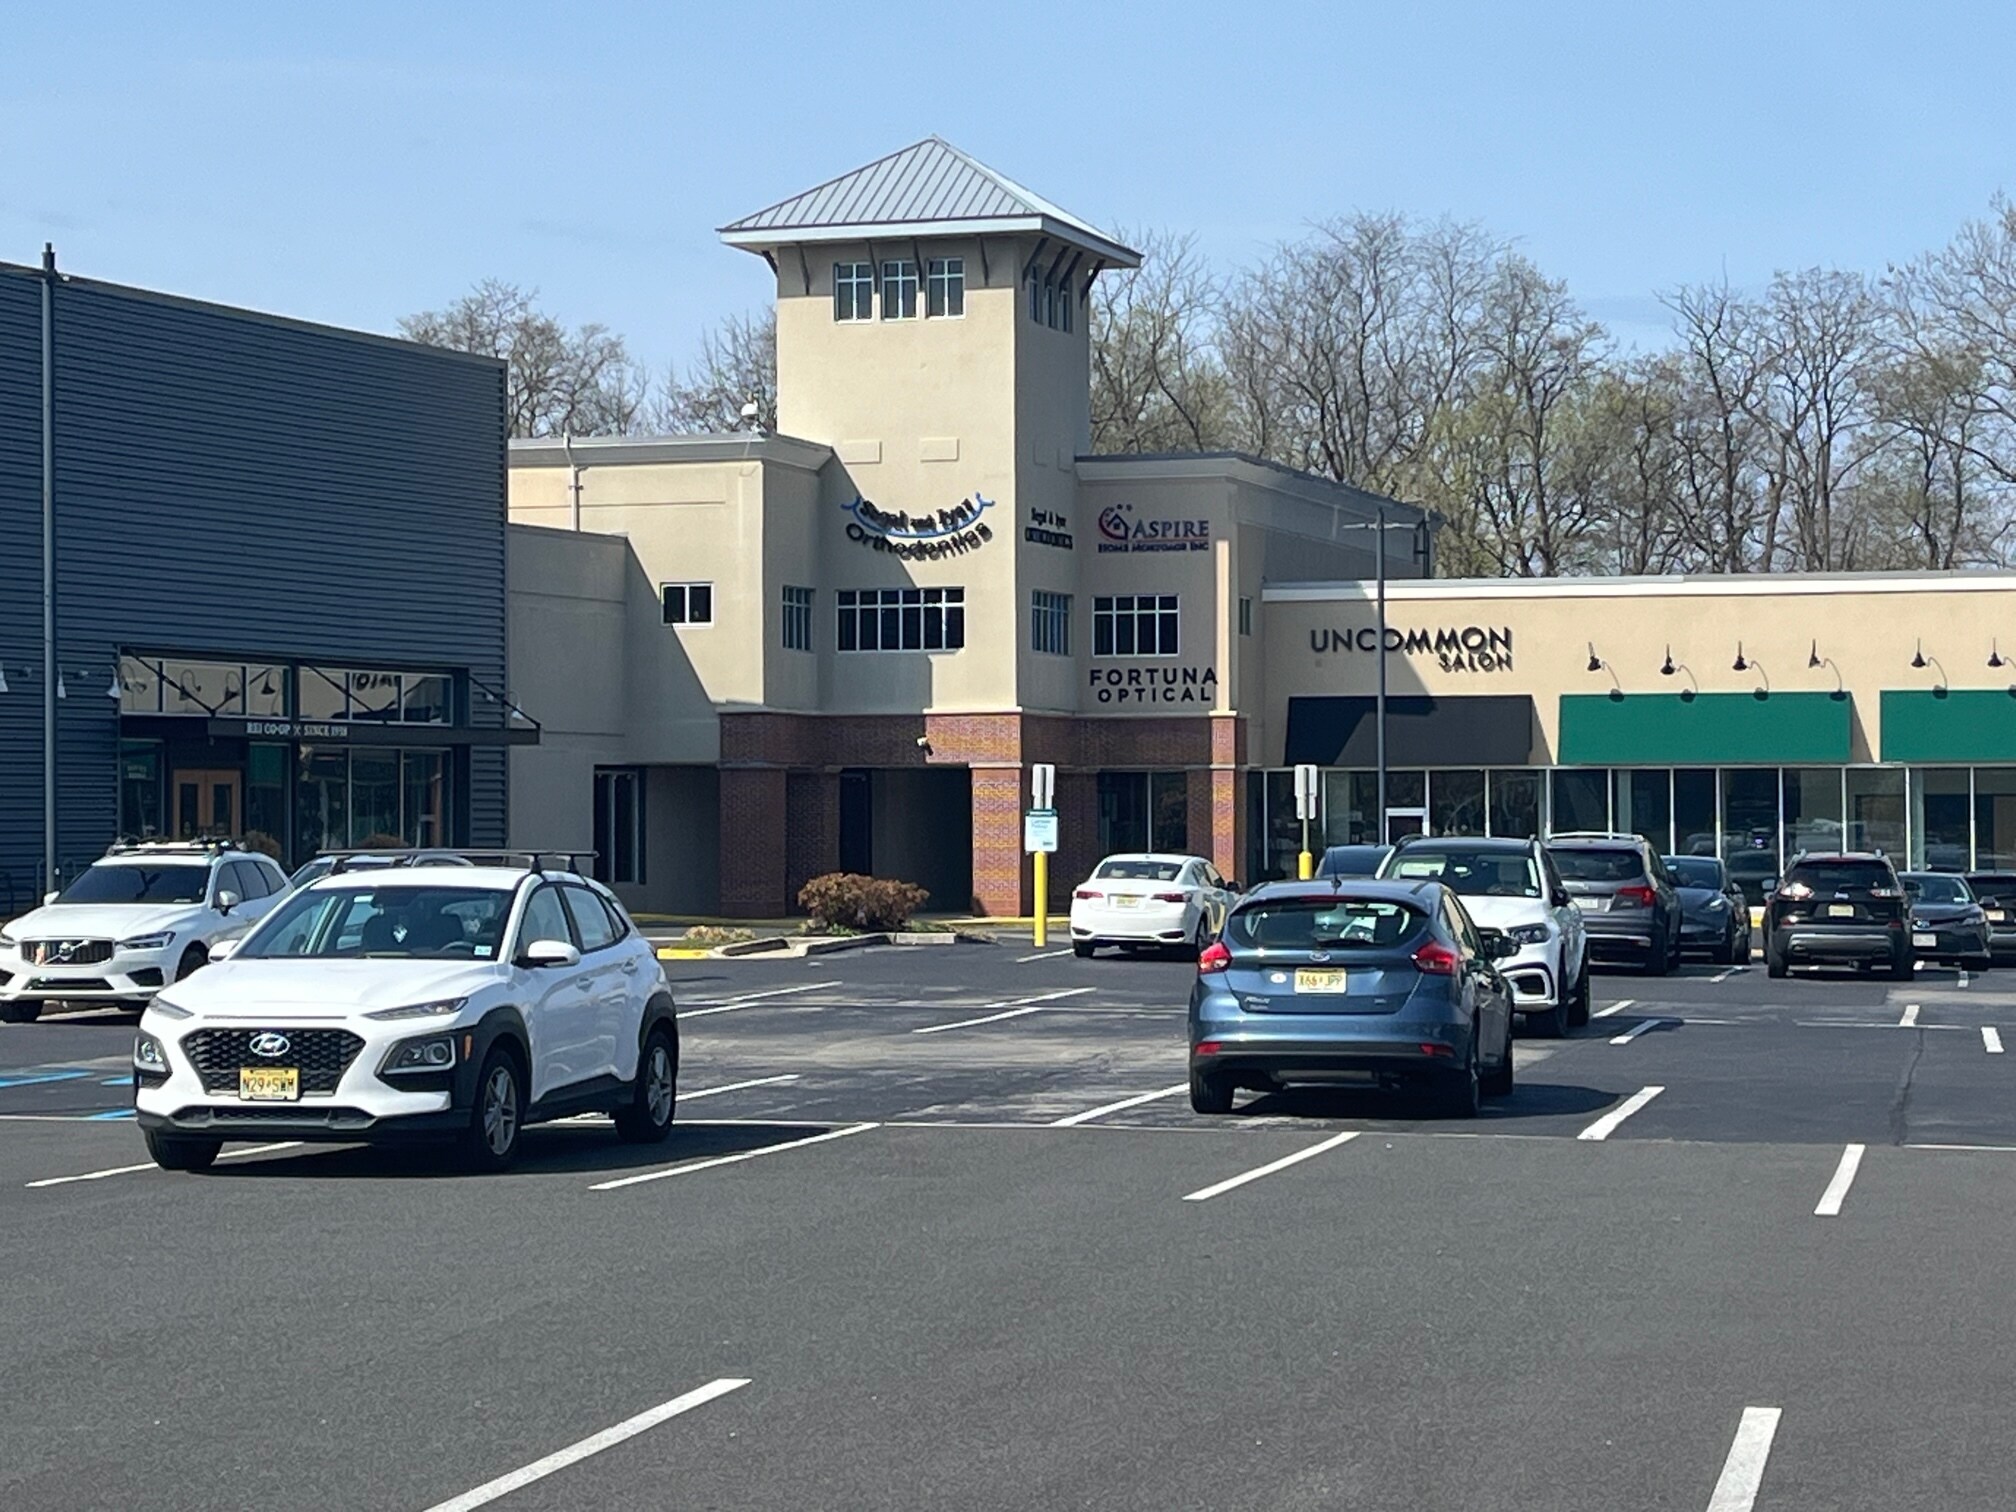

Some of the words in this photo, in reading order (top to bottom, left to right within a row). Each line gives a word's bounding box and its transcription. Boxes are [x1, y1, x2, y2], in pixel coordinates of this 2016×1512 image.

[1132, 518, 1209, 539] ASPIRE
[1310, 626, 1513, 655] UNCOMMON
[1438, 652, 1513, 673] SALON
[1090, 668, 1218, 686] FORTUNA
[1097, 687, 1212, 703] OPTICAL
